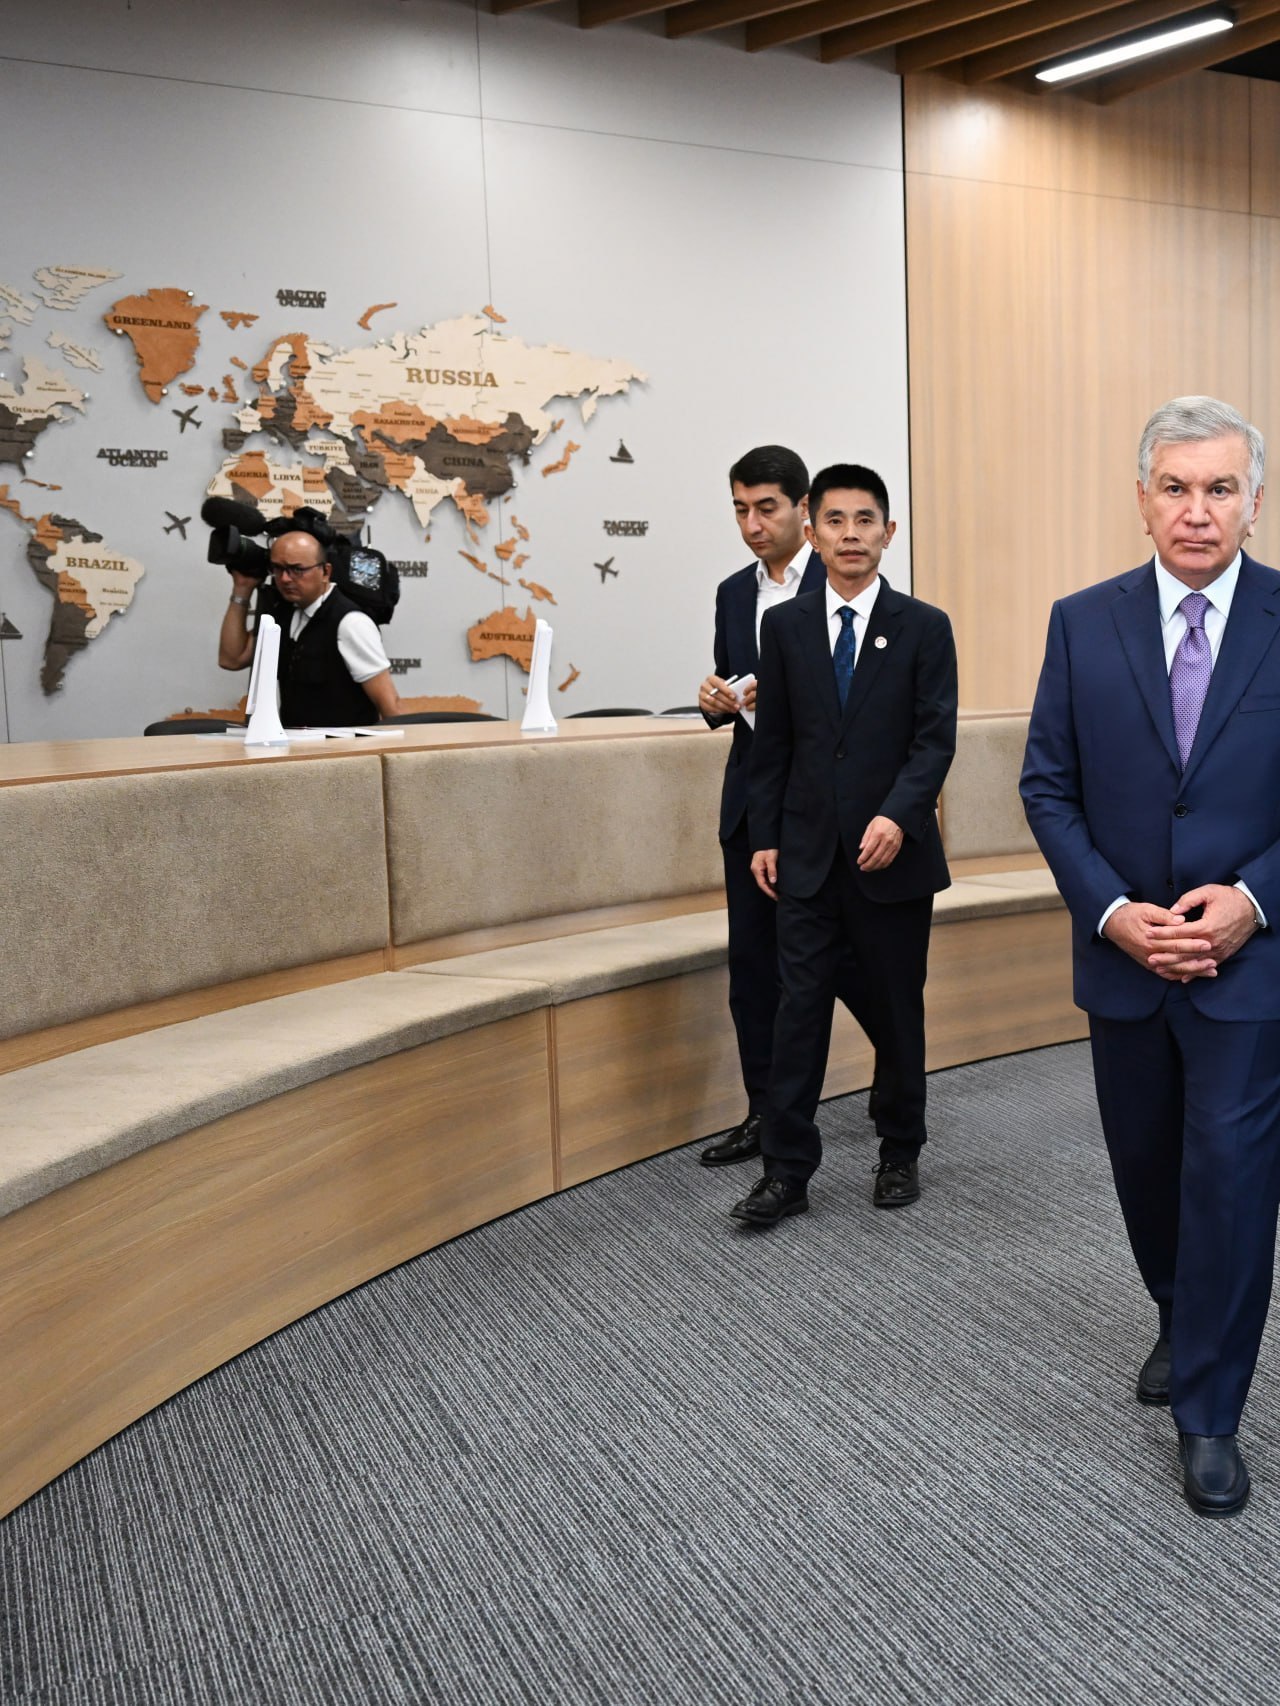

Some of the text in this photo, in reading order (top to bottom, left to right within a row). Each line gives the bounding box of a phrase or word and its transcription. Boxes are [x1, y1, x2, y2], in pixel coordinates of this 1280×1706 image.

[276, 288, 326, 301] ARCTIC
[279, 298, 324, 309] OCEAN
[113, 315, 192, 330] GREENLAND
[405, 367, 499, 388] RUSSIA
[96, 448, 168, 460] ATLANTIC
[108, 457, 157, 468] OCEAN
[442, 456, 486, 468] CHINA
[228, 470, 269, 479] ALGERIA
[273, 473, 301, 481] LIBYA
[416, 487, 439, 495] INDIA
[603, 520, 649, 530] PACIFIC
[607, 527, 646, 537] OCEAN
[66, 557, 129, 572] BRAZIL
[480, 632, 535, 642] AUSTRALI
